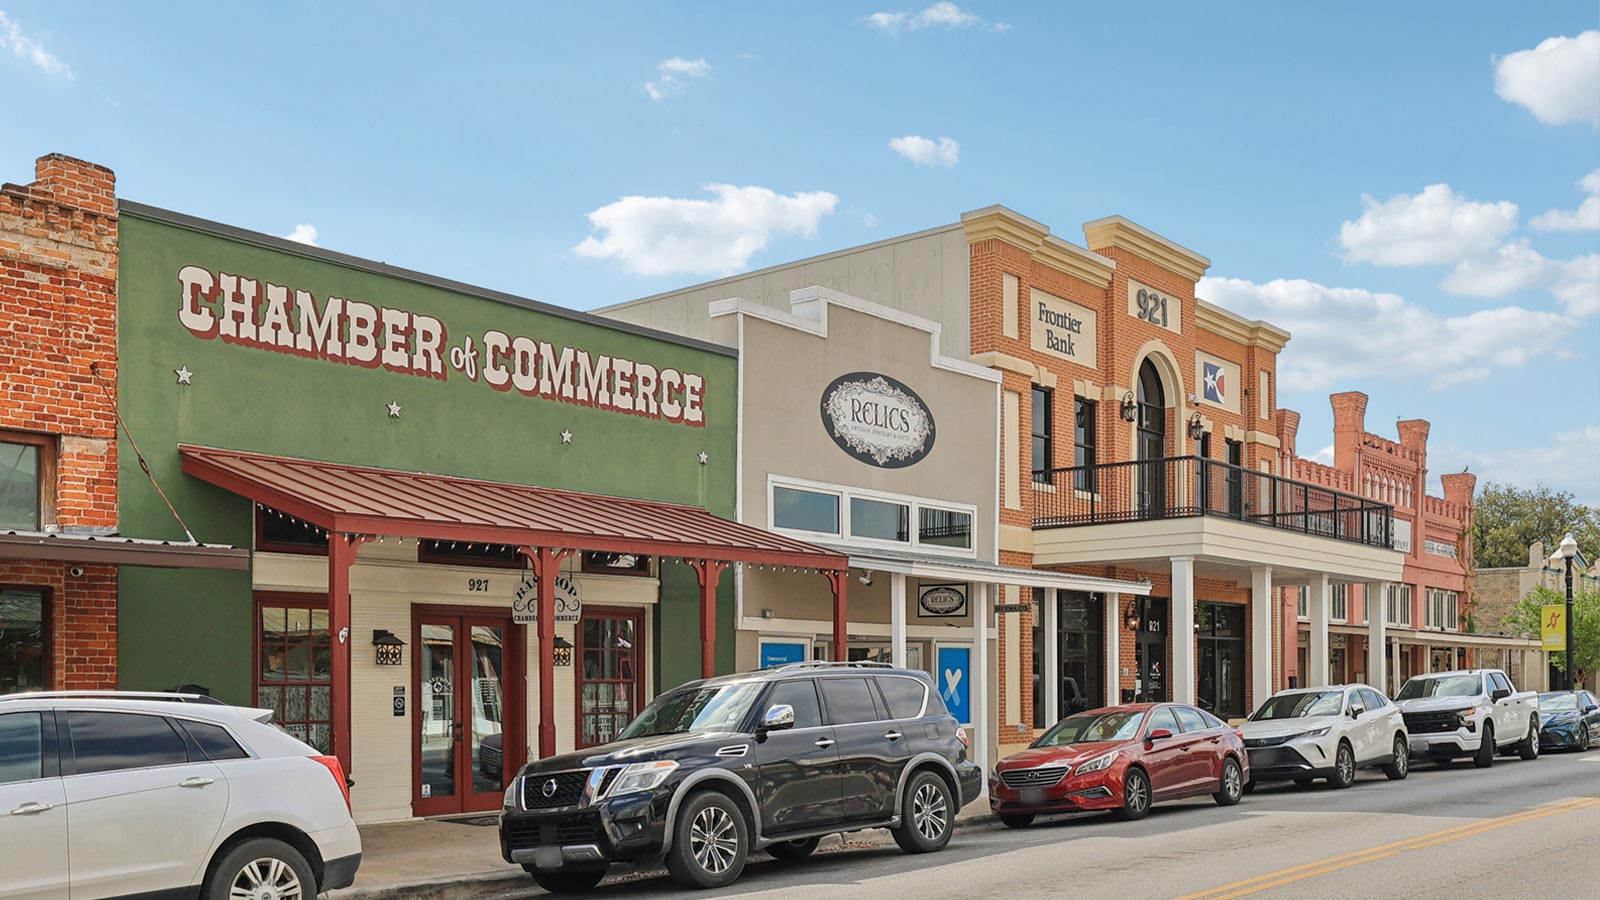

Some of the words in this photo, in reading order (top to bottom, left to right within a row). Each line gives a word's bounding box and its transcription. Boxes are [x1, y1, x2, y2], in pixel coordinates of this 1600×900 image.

[1038, 301, 1083, 335] Frontier
[1136, 288, 1168, 327] 921
[178, 264, 449, 382] CHAMBER
[450, 334, 480, 383] of
[482, 329, 706, 428] COMMERCE
[1045, 328, 1076, 357] Bank
[850, 397, 911, 434] RELICS
[468, 578, 490, 592] 927
[516, 576, 577, 600] BASOP
[930, 595, 955, 604] RELICS
[514, 614, 537, 622] CHAMBE
[555, 614, 579, 622] MMERCE
[1148, 620, 1160, 632] 921
